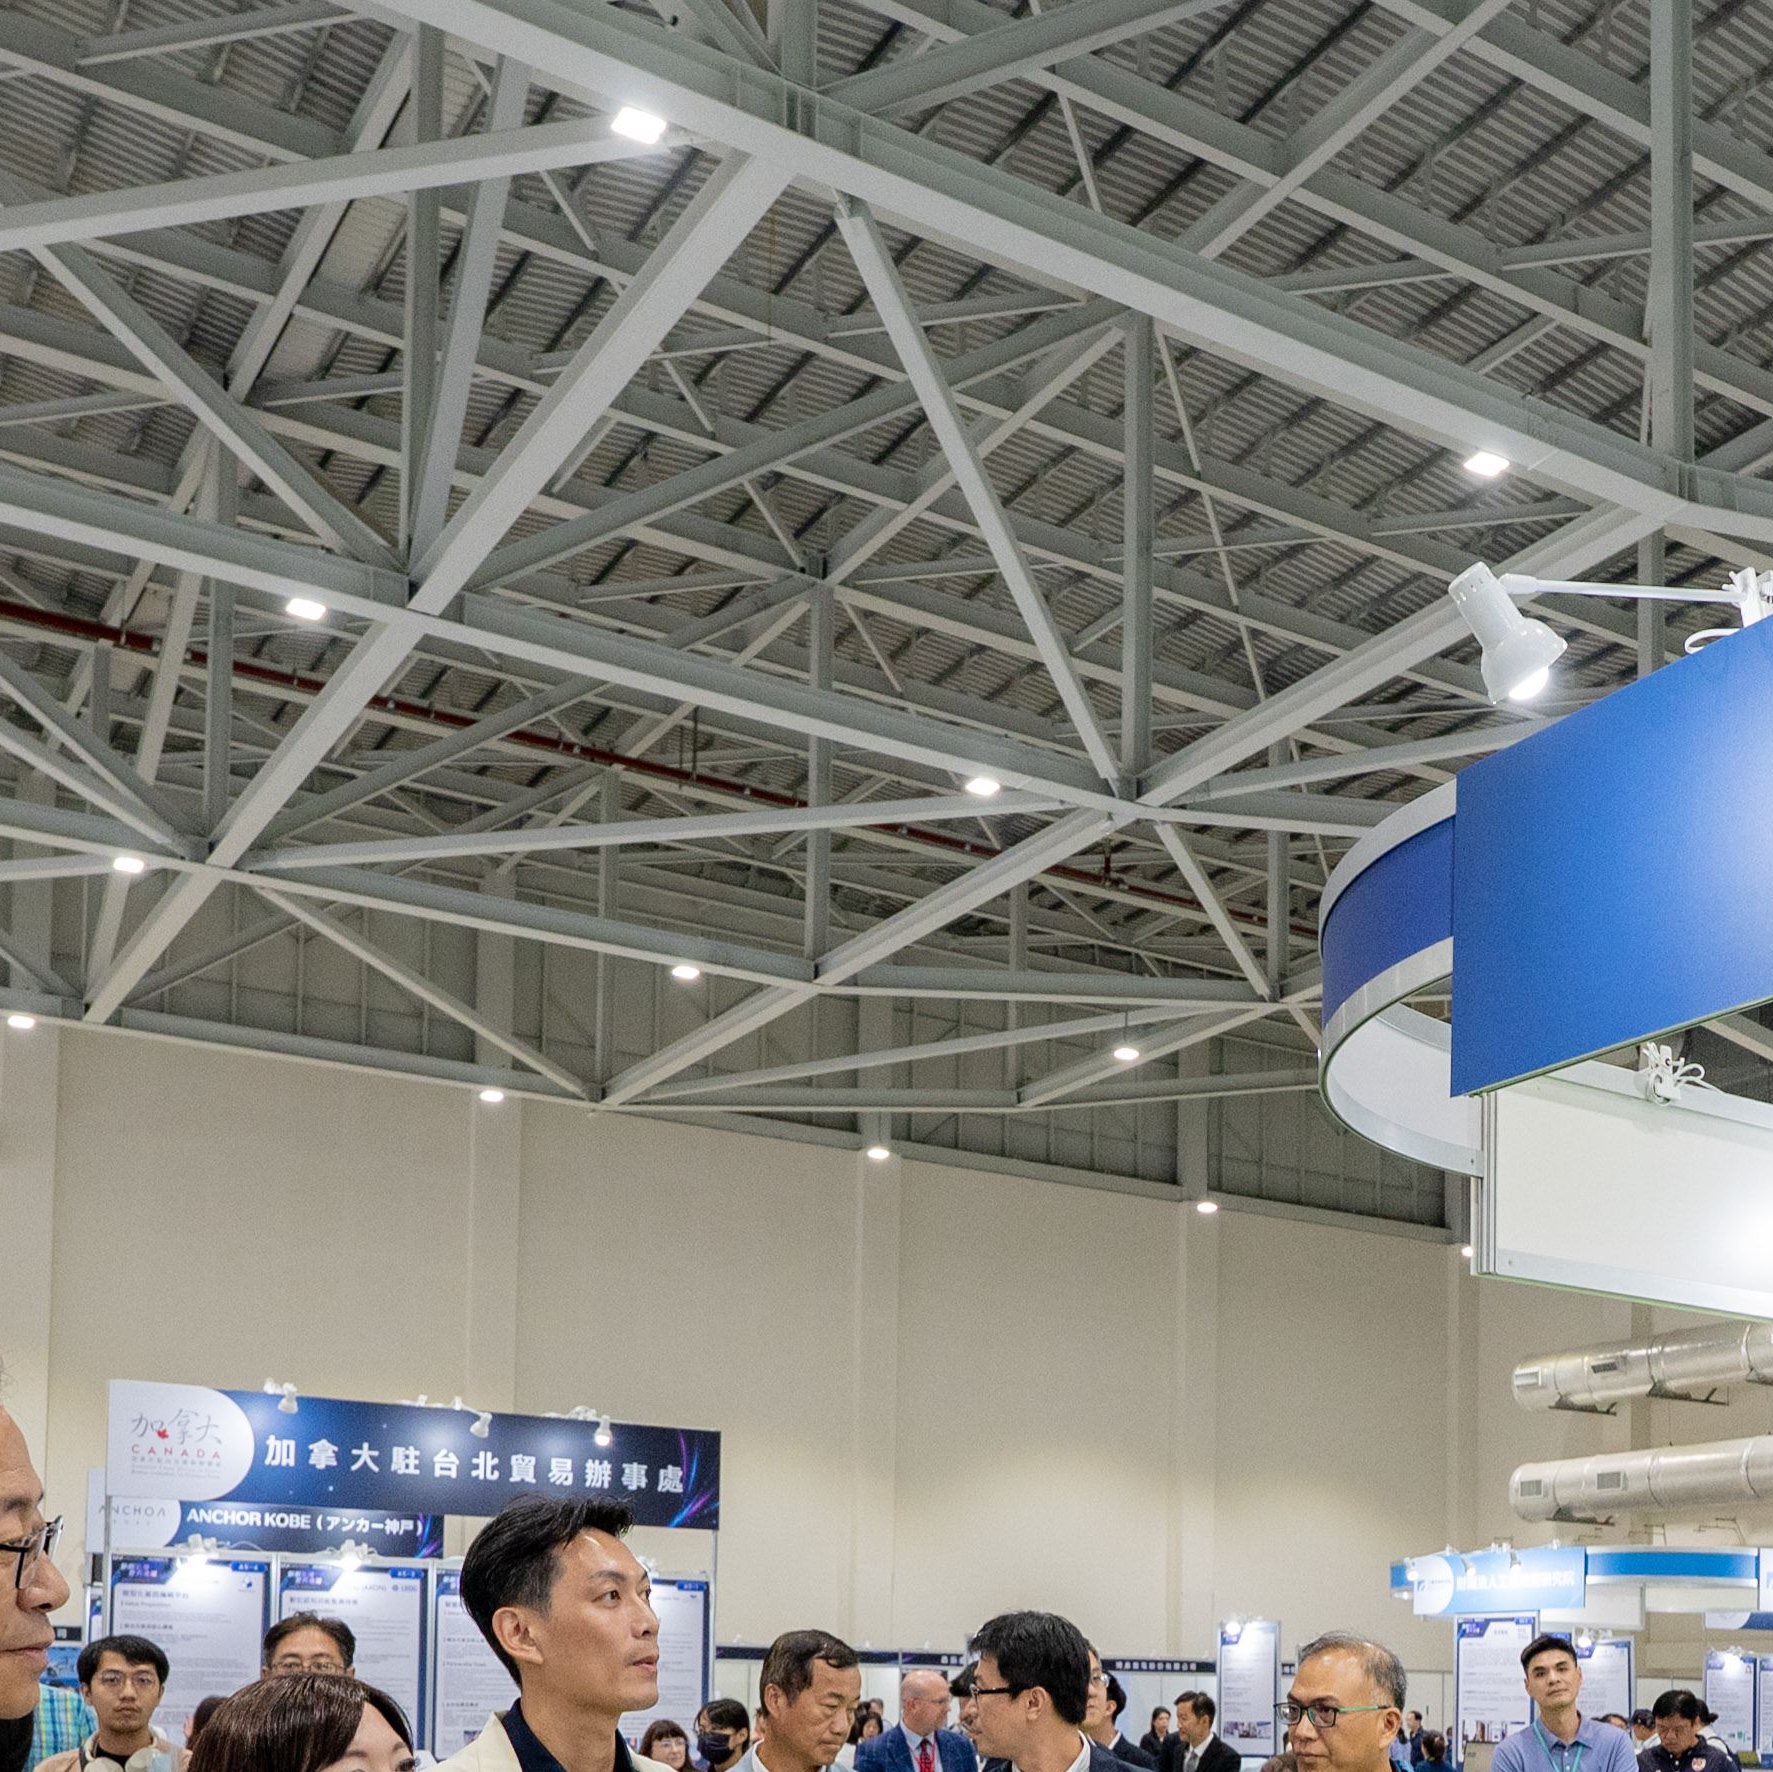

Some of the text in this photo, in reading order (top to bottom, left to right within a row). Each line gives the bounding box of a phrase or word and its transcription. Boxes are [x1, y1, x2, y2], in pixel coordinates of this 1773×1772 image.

[131, 1407, 222, 1446] 加拿大
[131, 1443, 221, 1460] CANADA
[265, 1434, 684, 1494] 加拿大駐台北貿易辦事處
[186, 1507, 261, 1527] ANCHOR
[263, 1510, 311, 1529] KOBE
